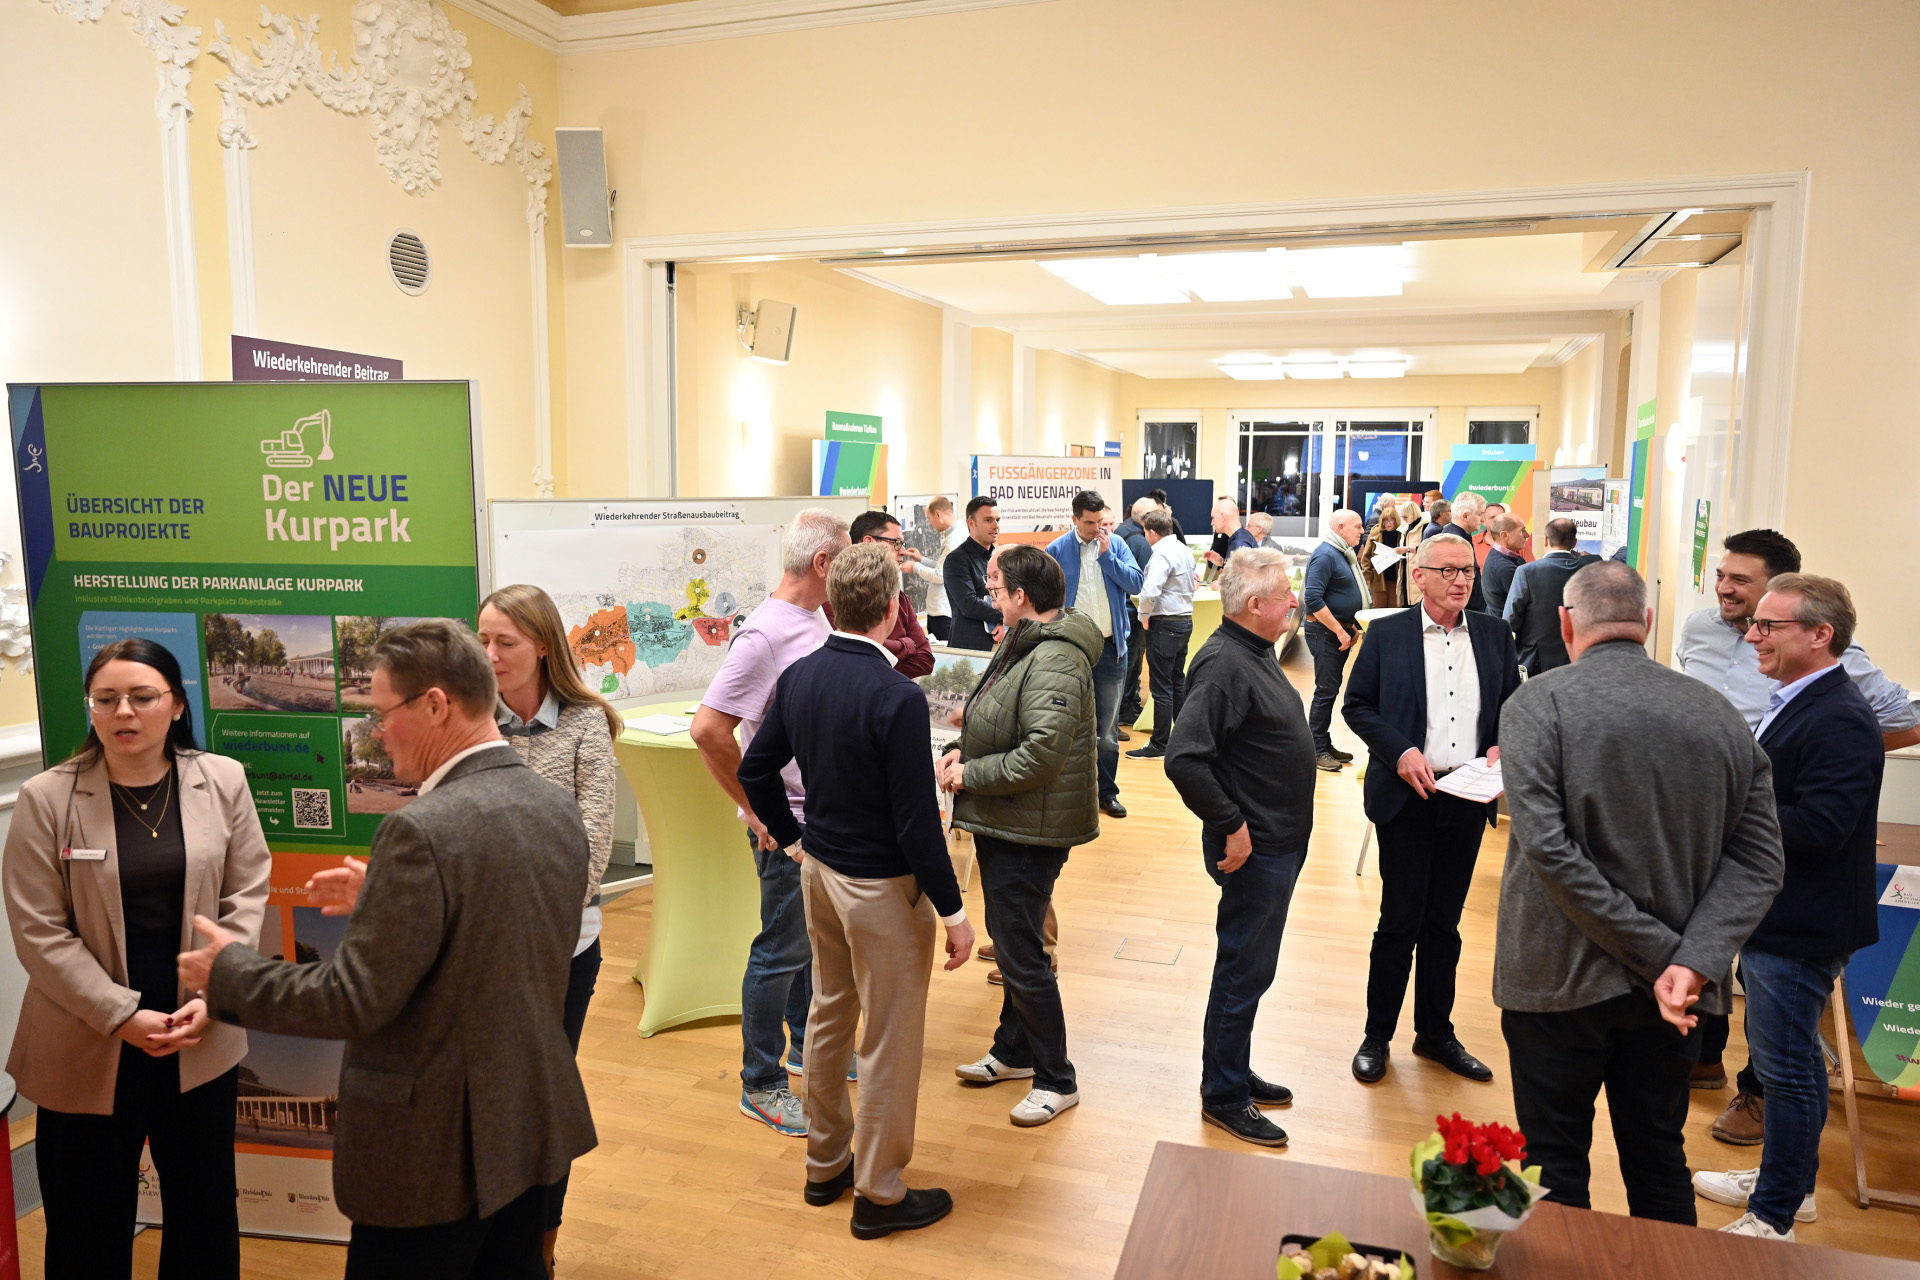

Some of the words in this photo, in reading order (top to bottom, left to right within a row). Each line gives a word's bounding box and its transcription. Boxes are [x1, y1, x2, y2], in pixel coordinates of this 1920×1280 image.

[252, 349, 353, 379] Wiederkehrender
[354, 363, 390, 380] Beitrag
[989, 463, 1097, 480] FUSSGÄNGERZONE
[1100, 467, 1111, 480] IN
[262, 474, 314, 501] Der
[323, 474, 408, 502] NEUE
[990, 486, 1014, 499] BAD
[1018, 486, 1082, 499] NEUENAHR
[66, 493, 164, 514] ÜBERSICHT
[169, 498, 205, 514] DER
[594, 512, 661, 521] Wiederkehrender
[662, 510, 740, 519] Straßenausbaubeitrag
[69, 522, 191, 540] BAUPROJEKTE
[265, 508, 411, 551] Kurpark
[74, 575, 168, 589] HERSTELLUNG
[172, 576, 199, 589] DER
[202, 577, 293, 591] PARKANLAGE
[297, 578, 364, 592] KURPARK
[75, 595, 109, 603] inklusive
[110, 595, 182, 606] Mühlenteichgraben
[200, 597, 236, 607] Parkplatz
[238, 597, 282, 607] Oberstraße
[222, 729, 248, 737] Weitere
[249, 730, 298, 739] Informationen
[299, 731, 311, 739] auf
[223, 741, 310, 753] wiederbunt.de
[1862, 996, 1904, 1009] Wieder
[1883, 1023, 1920, 1036] Wiede
